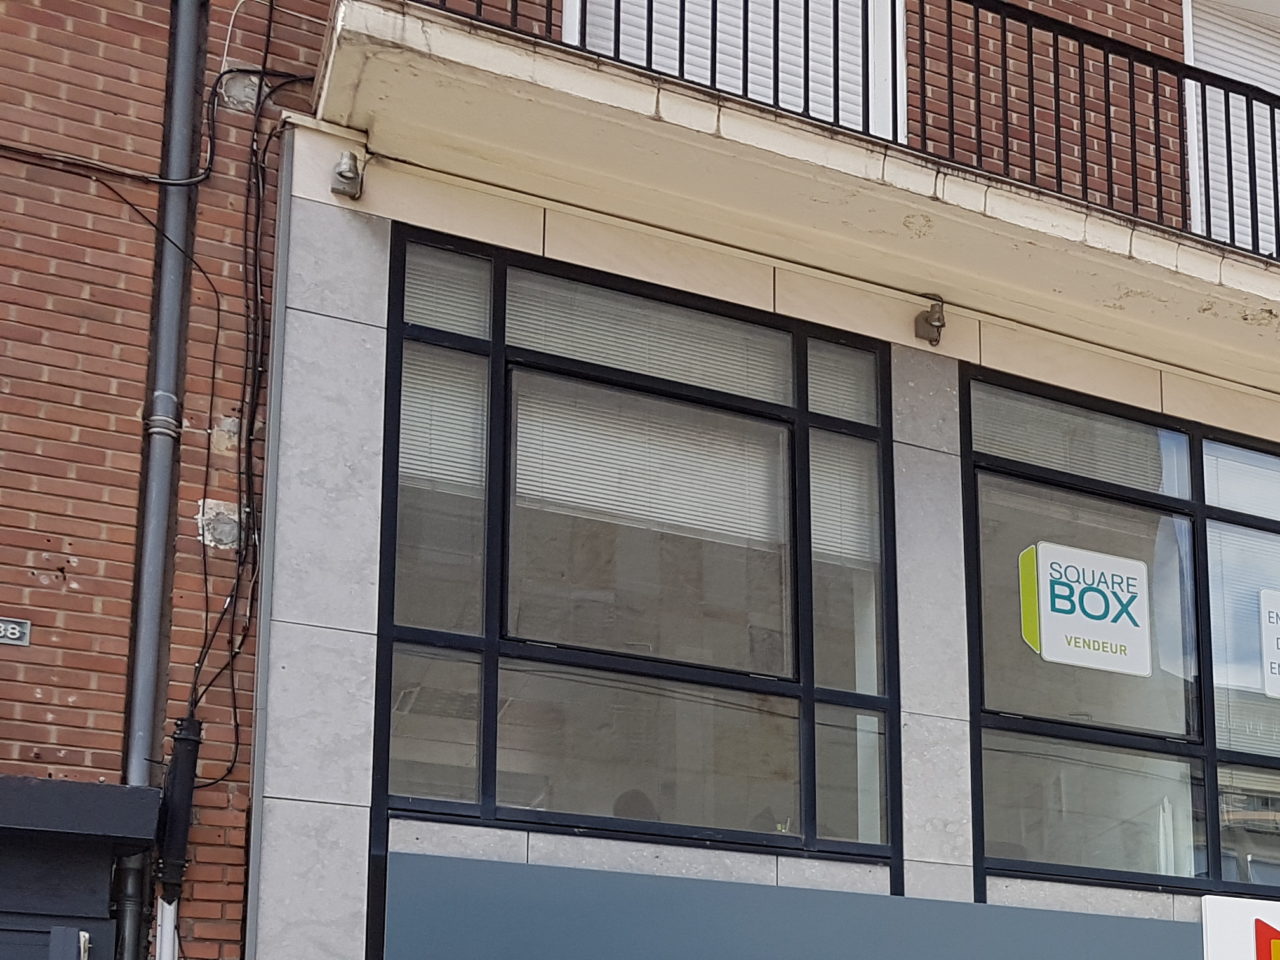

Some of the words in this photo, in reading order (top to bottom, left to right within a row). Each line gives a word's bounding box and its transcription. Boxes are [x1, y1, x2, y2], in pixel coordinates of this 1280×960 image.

[1049, 561, 1138, 595] SQUARE
[1049, 579, 1140, 628] BOX
[1064, 634, 1128, 656] VENDEUR
